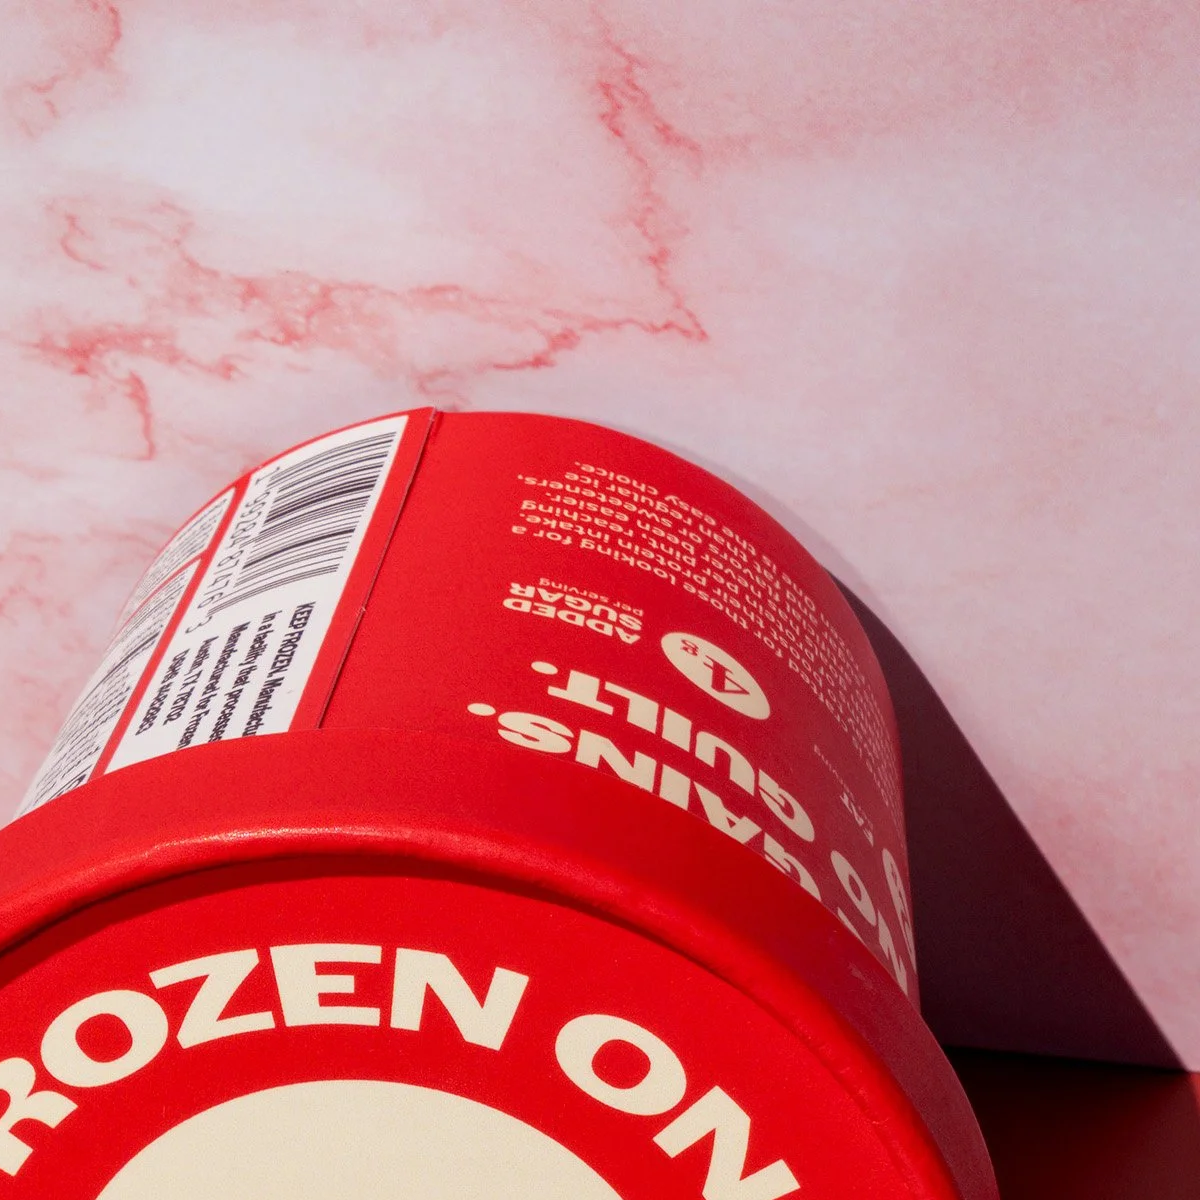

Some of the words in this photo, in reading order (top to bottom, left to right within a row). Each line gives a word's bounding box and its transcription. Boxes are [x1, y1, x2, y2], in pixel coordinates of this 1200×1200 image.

[254, 466, 280, 485] 1
[564, 471, 600, 489] ice
[574, 461, 659, 496] choice.
[228, 490, 271, 548] 99284
[517, 474, 673, 529] sweeteners,
[520, 499, 634, 538] reaching
[546, 491, 630, 523] easier.
[605, 483, 693, 526] regular
[664, 494, 717, 526] easy
[511, 525, 527, 535] a
[519, 513, 610, 544] intake.
[532, 529, 573, 546] for
[636, 519, 695, 555] been
[678, 527, 703, 544] or
[699, 524, 748, 564] than
[722, 526, 757, 557] the
[579, 538, 677, 586] looking
[617, 538, 707, 587] protein
[641, 533, 697, 568] pint,
[762, 555, 777, 574] is
[197, 549, 245, 609] 87476
[538, 577, 610, 603] serving
[700, 553, 762, 600] never
[702, 568, 739, 595] per
[708, 543, 781, 602] flavors
[752, 560, 782, 590] fat
[781, 572, 816, 612] One
[288, 601, 316, 630] KEEP
[502, 597, 641, 644] ADDED
[509, 581, 643, 631] SUGAR
[613, 600, 644, 617] per
[682, 580, 749, 630] those
[712, 587, 765, 629] their
[767, 598, 800, 637] has
[785, 589, 818, 626] and
[185, 615, 213, 635] 3
[745, 594, 815, 663] protein
[753, 630, 784, 659] for
[784, 600, 851, 684] artificial
[184, 635, 219, 677] Austin,
[201, 621, 251, 697] Manufactured
[238, 629, 275, 667] facility
[266, 630, 305, 679] FROZEN.
[768, 627, 823, 687] boost
[179, 669, 203, 690] TX
[231, 664, 258, 690] that
[788, 658, 848, 733] crafted
[195, 693, 217, 712] for
[241, 676, 286, 737] Manufactu
[176, 708, 211, 750] Frozen
[531, 661, 815, 843] GUILT.
[467, 702, 822, 901] GAINS.
[840, 792, 875, 848] FAT
